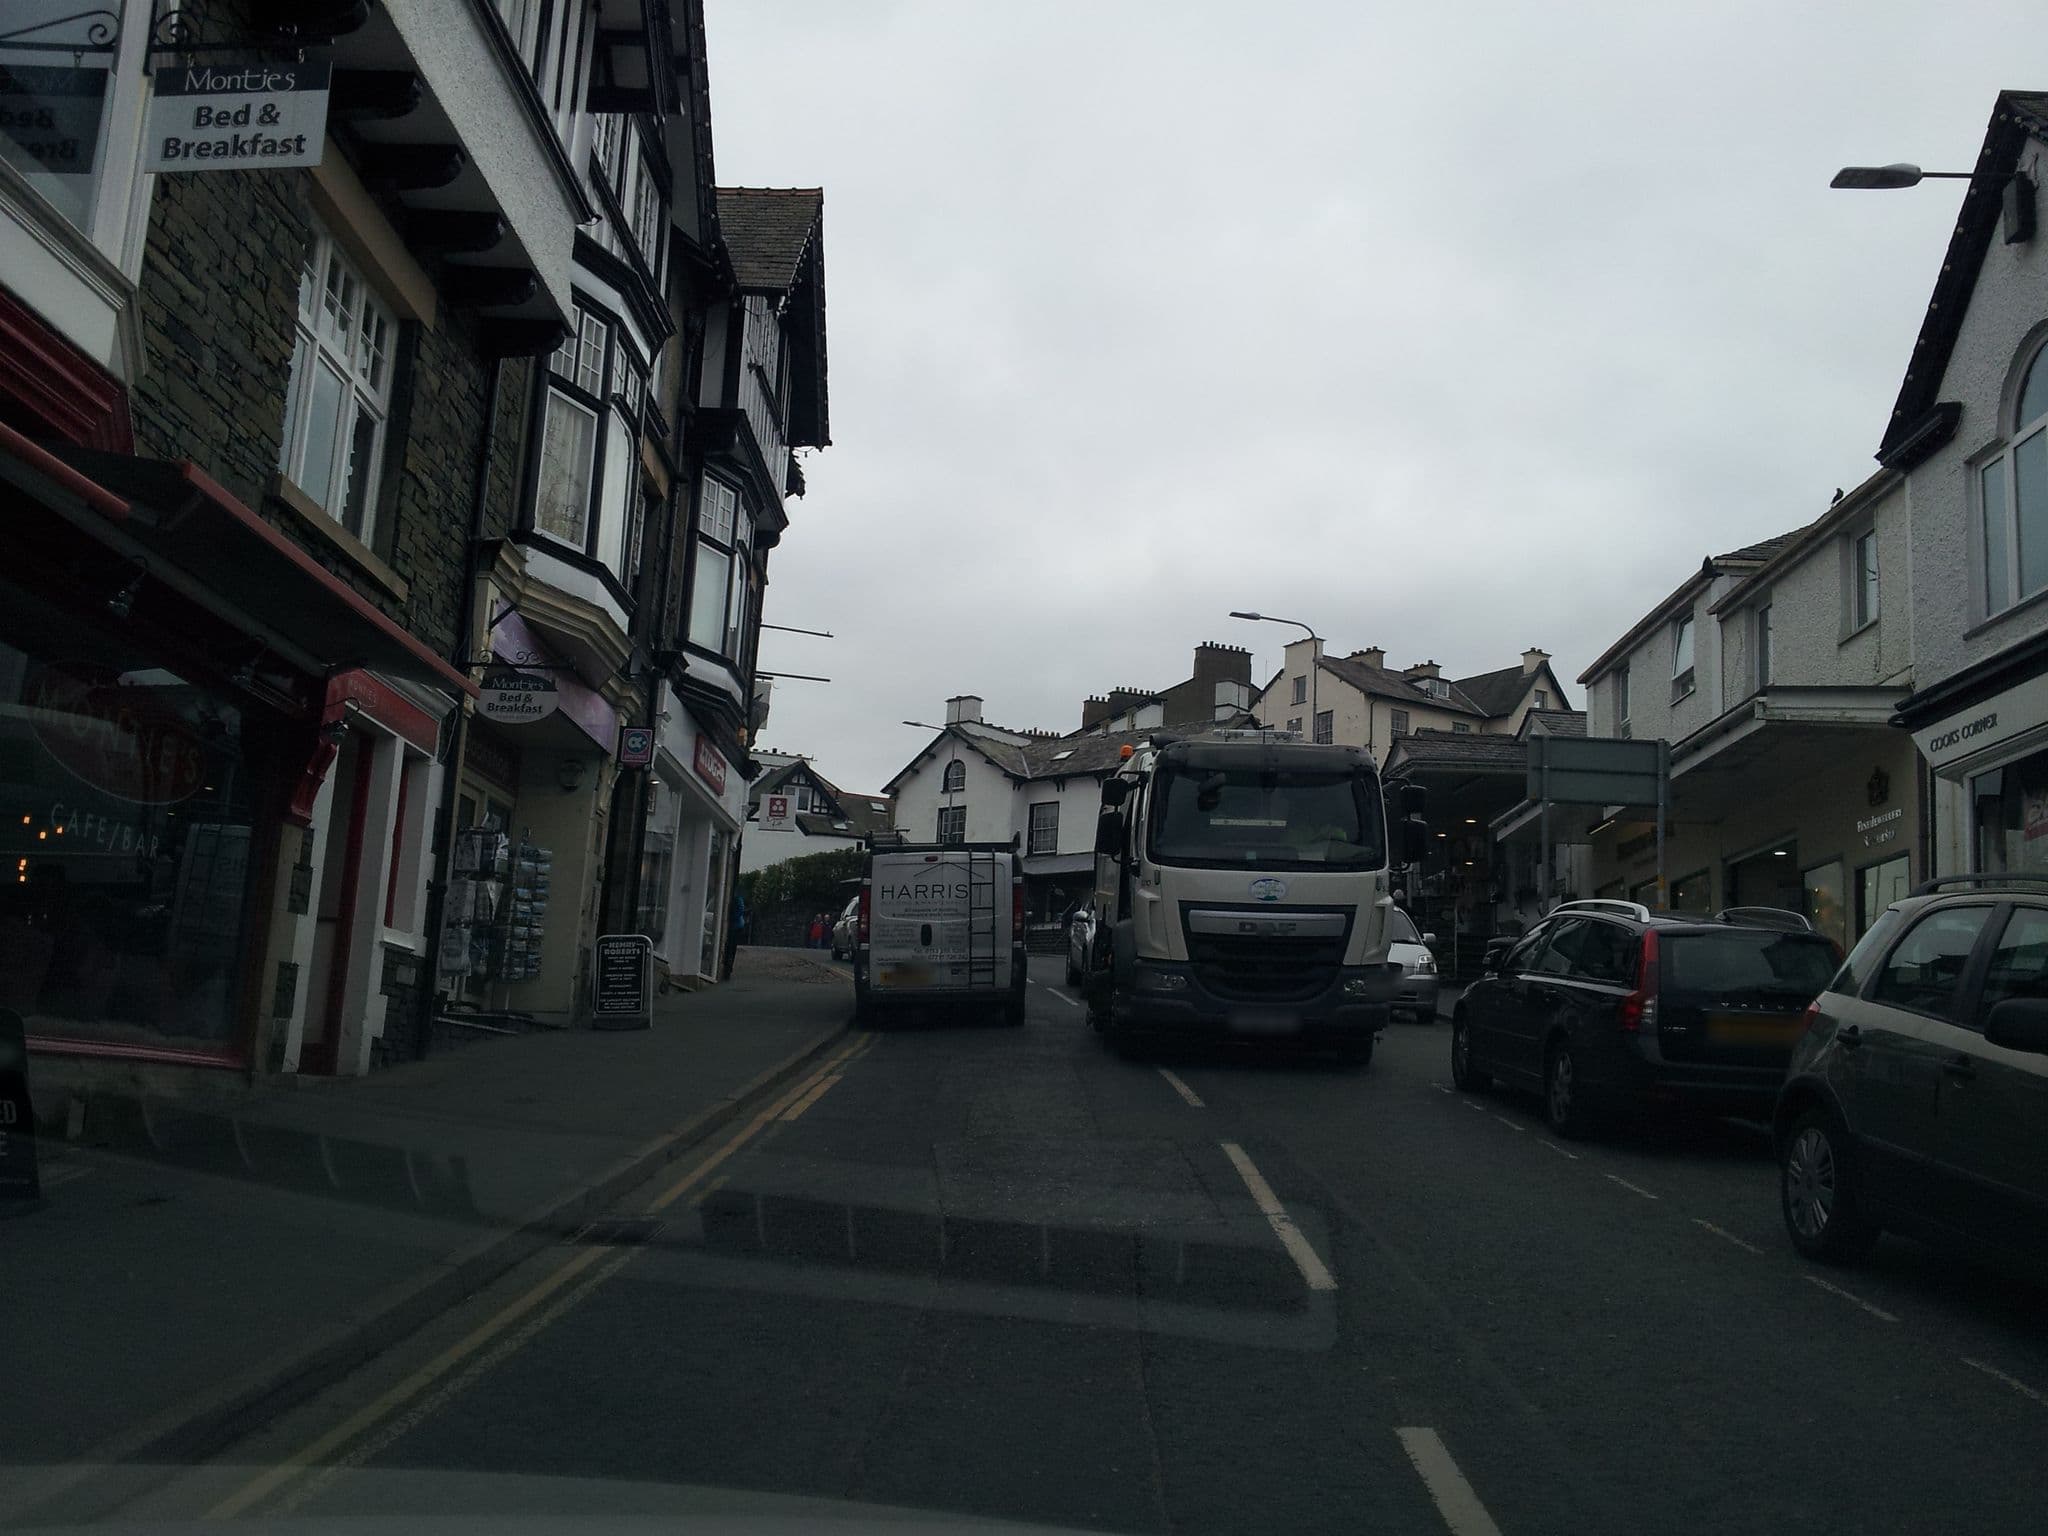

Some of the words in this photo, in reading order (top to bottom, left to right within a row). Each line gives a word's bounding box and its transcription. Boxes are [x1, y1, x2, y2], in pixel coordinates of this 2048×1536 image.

[184, 67, 297, 92] Monties
[194, 103, 252, 129] Bed
[257, 103, 281, 126] &
[161, 133, 307, 161] Breakfast
[487, 702, 543, 713] Breakfast
[500, 692, 522, 702] Bed
[524, 693, 534, 703] &
[1961, 712, 1998, 740] CORNER
[881, 884, 969, 900] HARRIS
